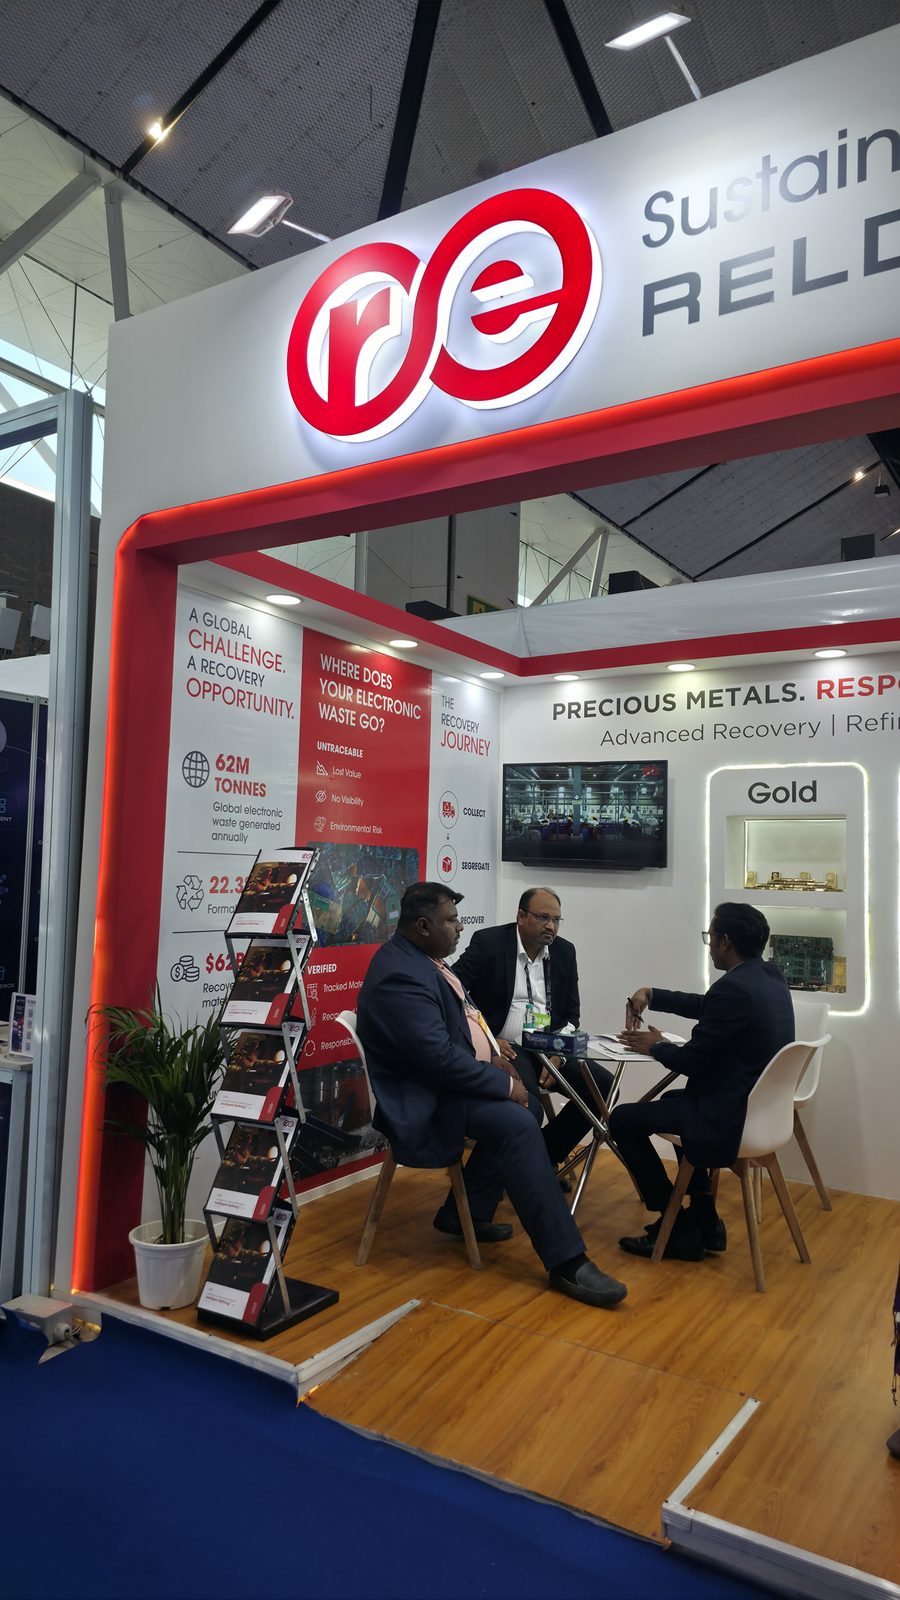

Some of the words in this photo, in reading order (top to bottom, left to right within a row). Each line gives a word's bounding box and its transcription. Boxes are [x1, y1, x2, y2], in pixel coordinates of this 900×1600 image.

[642, 127, 900, 249] Sustain
[189, 608, 199, 623] A
[203, 611, 252, 640] GLOBAL
[188, 629, 286, 673] CHALLENGE.
[187, 655, 197, 671] A
[201, 658, 265, 687] RECOVERY
[320, 653, 360, 680] WHERE
[363, 667, 393, 690] DOES
[186, 677, 294, 719] OPPORTUNITY.
[319, 677, 354, 702] YOUR
[356, 688, 421, 720] ELECTRONIC
[441, 694, 454, 710] THE
[552, 693, 677, 721] PRECIOUS
[686, 682, 805, 710] METALS.
[816, 674, 900, 701] RESP
[319, 702, 356, 727] WASTE
[360, 713, 385, 733] GO?
[441, 713, 480, 734] RECOVERY
[600, 724, 705, 747] Advanced
[713, 718, 821, 740] Recovery
[847, 711, 900, 733] Refi
[317, 740, 363, 758] UNTRACEABLE
[440, 729, 491, 757] JOURNEY
[215, 753, 250, 775] 62M
[332, 766, 344, 776] Lost
[345, 768, 362, 779] Value
[214, 777, 267, 798] TONNES
[747, 780, 818, 804] Gold
[331, 793, 340, 804] No
[341, 795, 365, 807] Visibility
[212, 801, 243, 814] Global
[244, 805, 283, 818] electronic
[462, 807, 486, 818] COLLECT
[212, 817, 237, 828] waste
[239, 820, 281, 831] generated
[330, 821, 372, 833] Environmental
[372, 825, 383, 834] Risk
[211, 832, 249, 844] annually
[461, 860, 490, 871] SEGREGATE
[209, 875, 249, 894] 22.3
[207, 903, 236, 915] Forma
[460, 915, 485, 925] RECOVER
[307, 963, 337, 975] VERIFIED
[203, 982, 234, 994] Recove
[323, 982, 348, 993] Tracked
[348, 980, 364, 989] Mate
[202, 996, 226, 1008] mate
[322, 1012, 340, 1021] Reco
